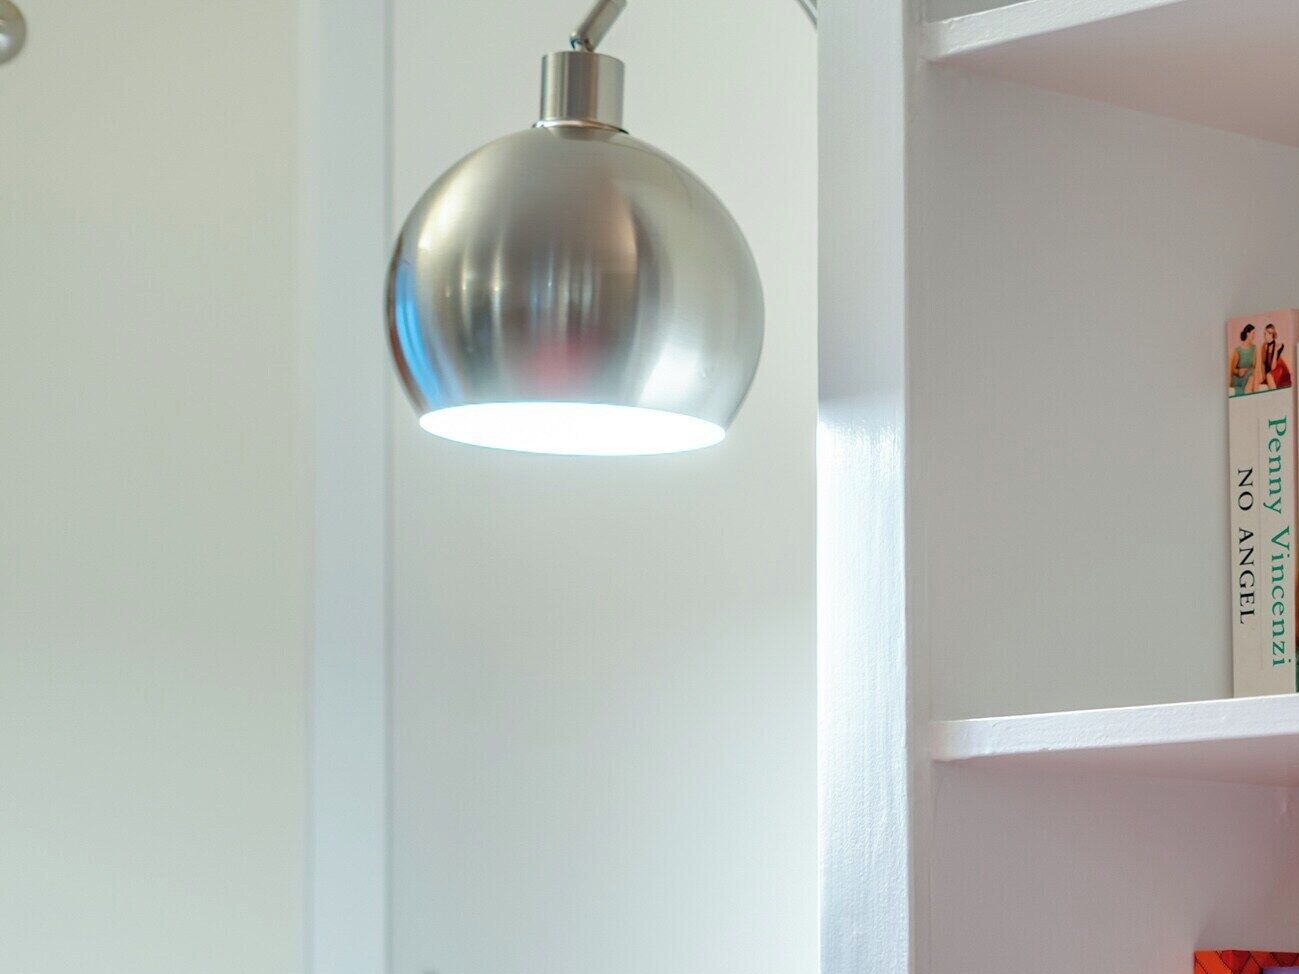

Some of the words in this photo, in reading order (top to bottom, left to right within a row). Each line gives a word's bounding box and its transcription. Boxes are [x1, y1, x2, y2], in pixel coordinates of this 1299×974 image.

[1238, 469, 1254, 510] NO
[1264, 416, 1287, 514] Penny
[1238, 528, 1255, 624] ANGEL
[1271, 526, 1291, 666] Vincenzi
